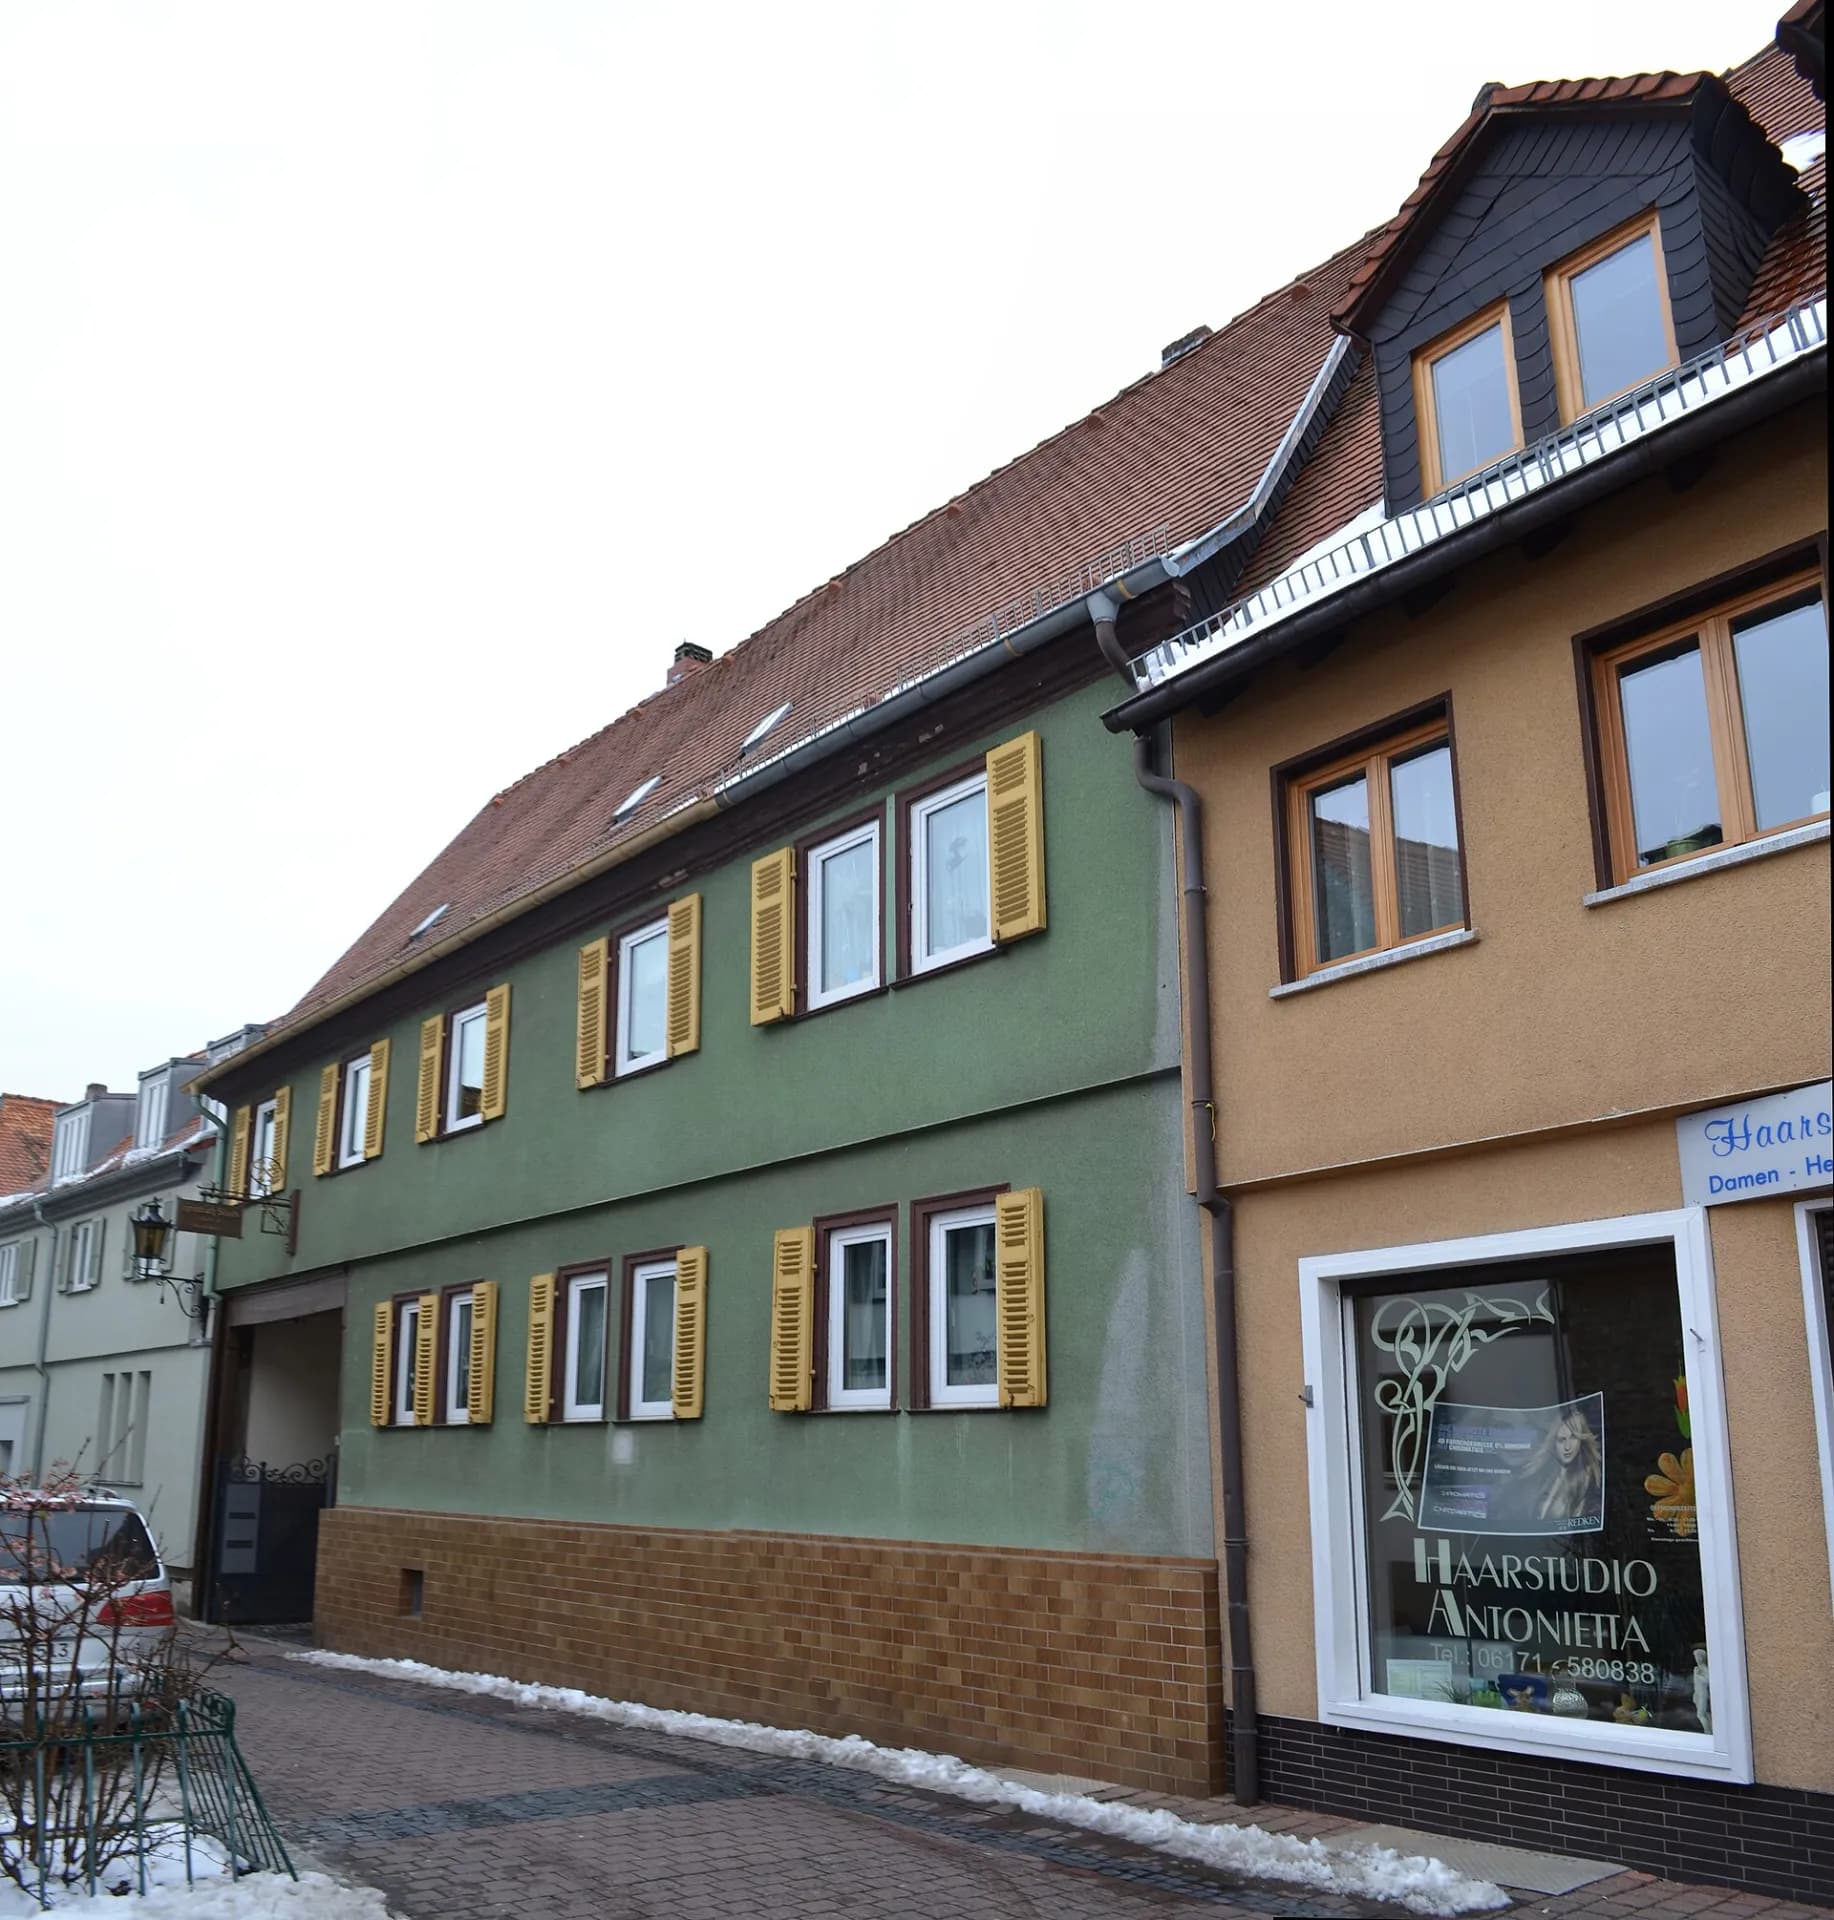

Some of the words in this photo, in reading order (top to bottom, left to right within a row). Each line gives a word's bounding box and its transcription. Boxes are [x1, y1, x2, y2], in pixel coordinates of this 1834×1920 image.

[1704, 1112, 1832, 1157] Haars
[1709, 1169, 1779, 1194] Damen
[1567, 1515, 1600, 1527] REDKEN
[1413, 1537, 1658, 1597] HAARSTUDIO
[1427, 1589, 1650, 1653] ANTONIETTA
[1477, 1648, 1541, 1673] 06171
[1567, 1656, 1655, 1684] 580838
